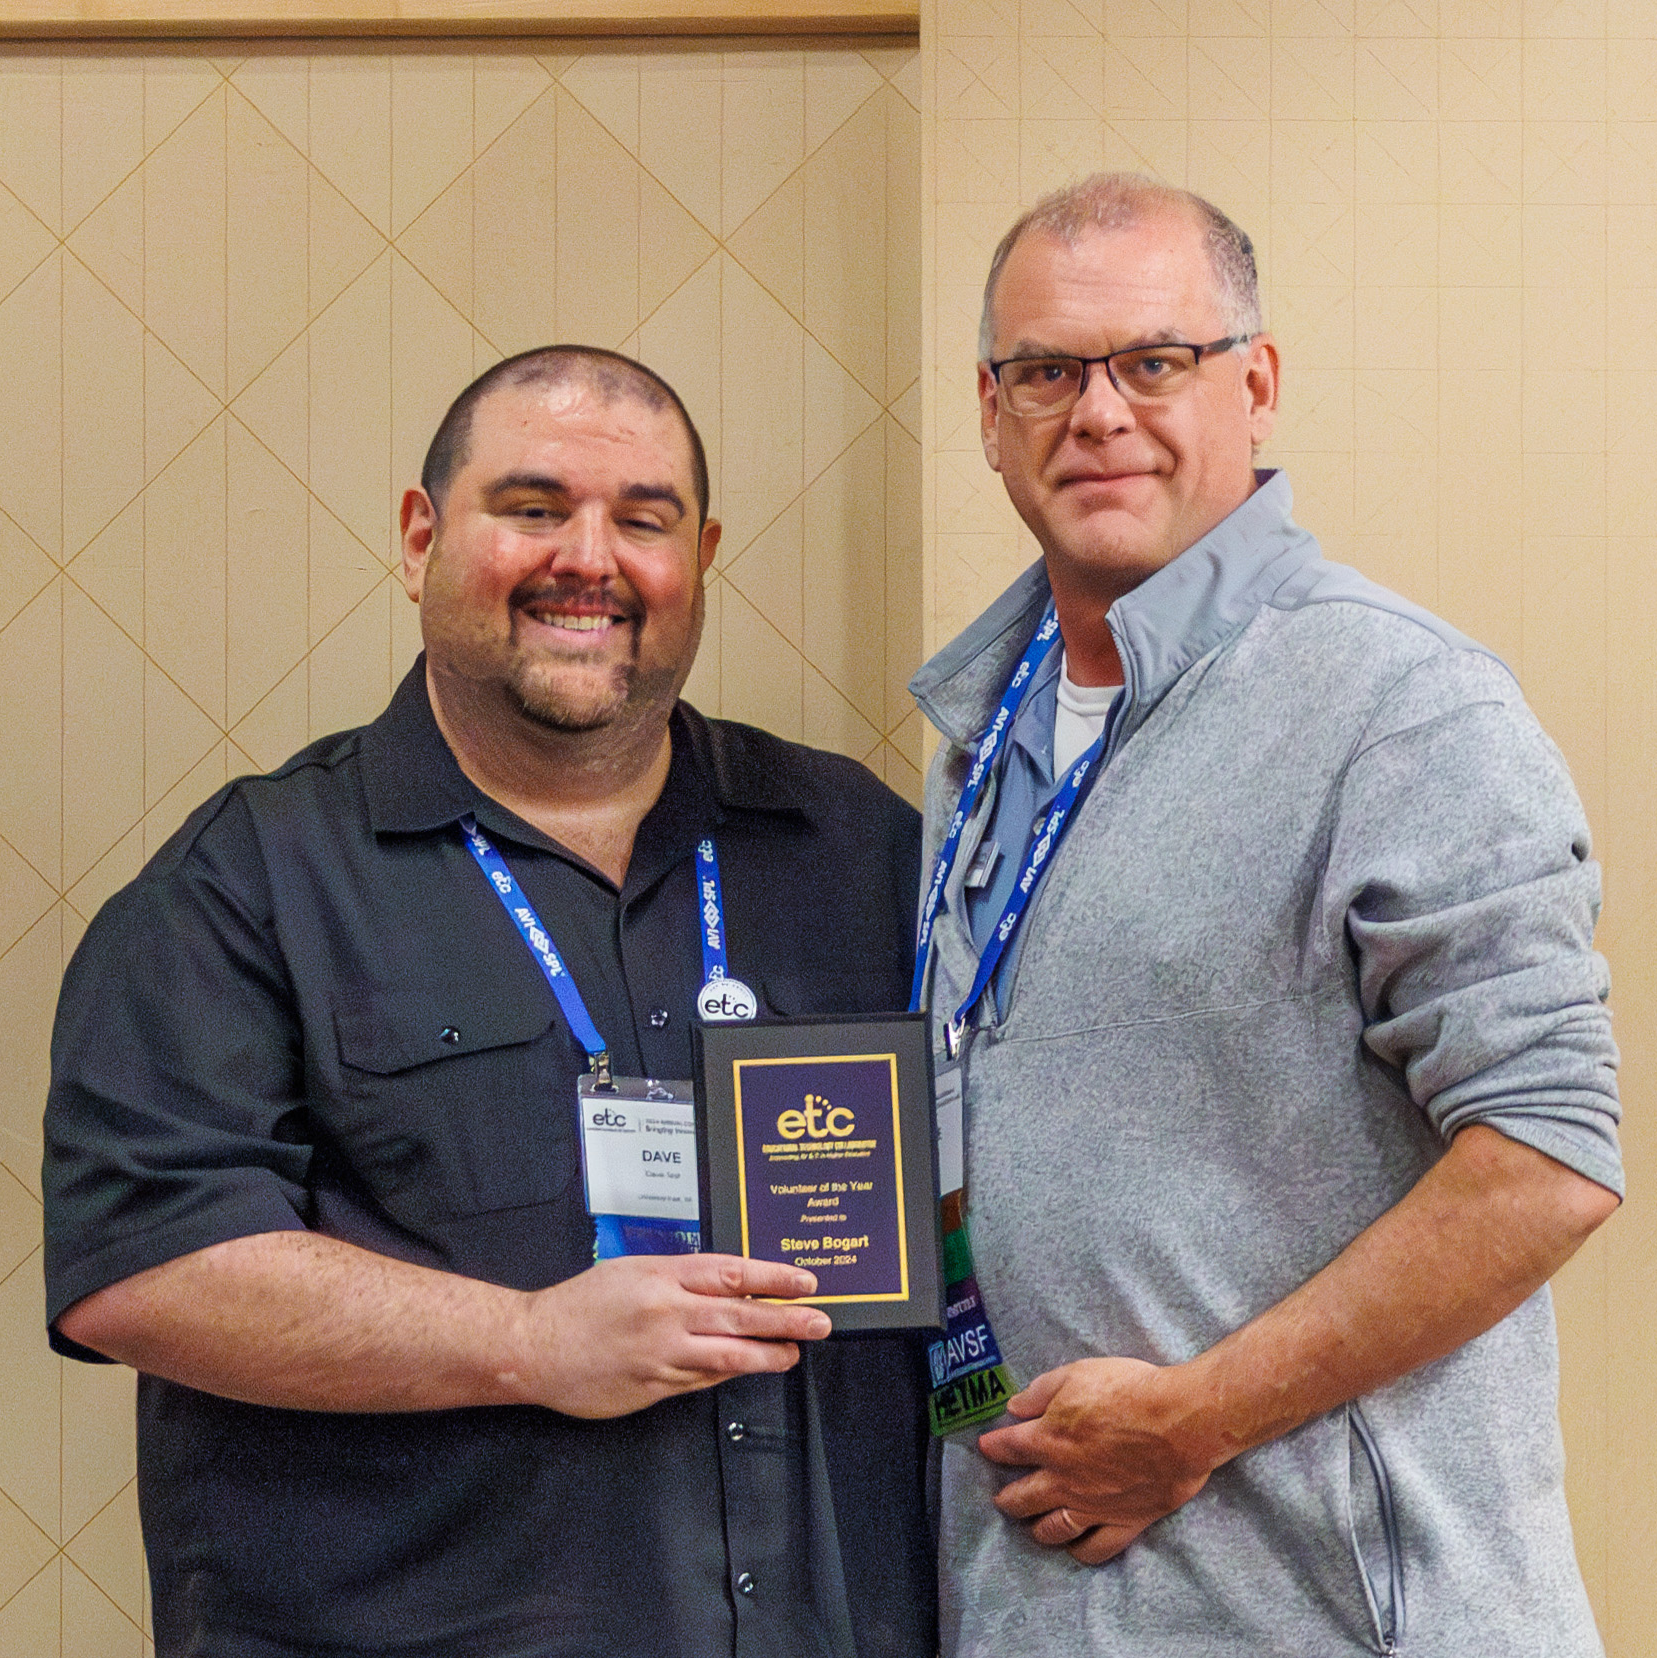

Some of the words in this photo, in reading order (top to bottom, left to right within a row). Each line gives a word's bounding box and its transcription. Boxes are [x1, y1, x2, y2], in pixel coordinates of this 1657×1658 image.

[967, 763, 985, 788] SPL
[1020, 867, 1037, 893] AVI
[1047, 809, 1065, 835] SPL
[492, 871, 512, 894] etc
[514, 907, 536, 928] AVI
[543, 953, 563, 977] SPL
[707, 928, 721, 950] AVI
[704, 993, 749, 1018] etc
[592, 1108, 627, 1127] etc
[777, 1094, 855, 1140] etc
[642, 1149, 682, 1164] DAVE
[770, 1184, 818, 1195] Volunteer
[819, 1182, 830, 1193] of
[831, 1182, 848, 1192] the
[849, 1181, 873, 1191] Year
[807, 1197, 840, 1208] Award
[781, 1238, 820, 1252] Steve
[822, 1235, 869, 1252] Bogart
[794, 1257, 832, 1267] October
[833, 1255, 858, 1265] 2024
[947, 1324, 989, 1367] AVSF
